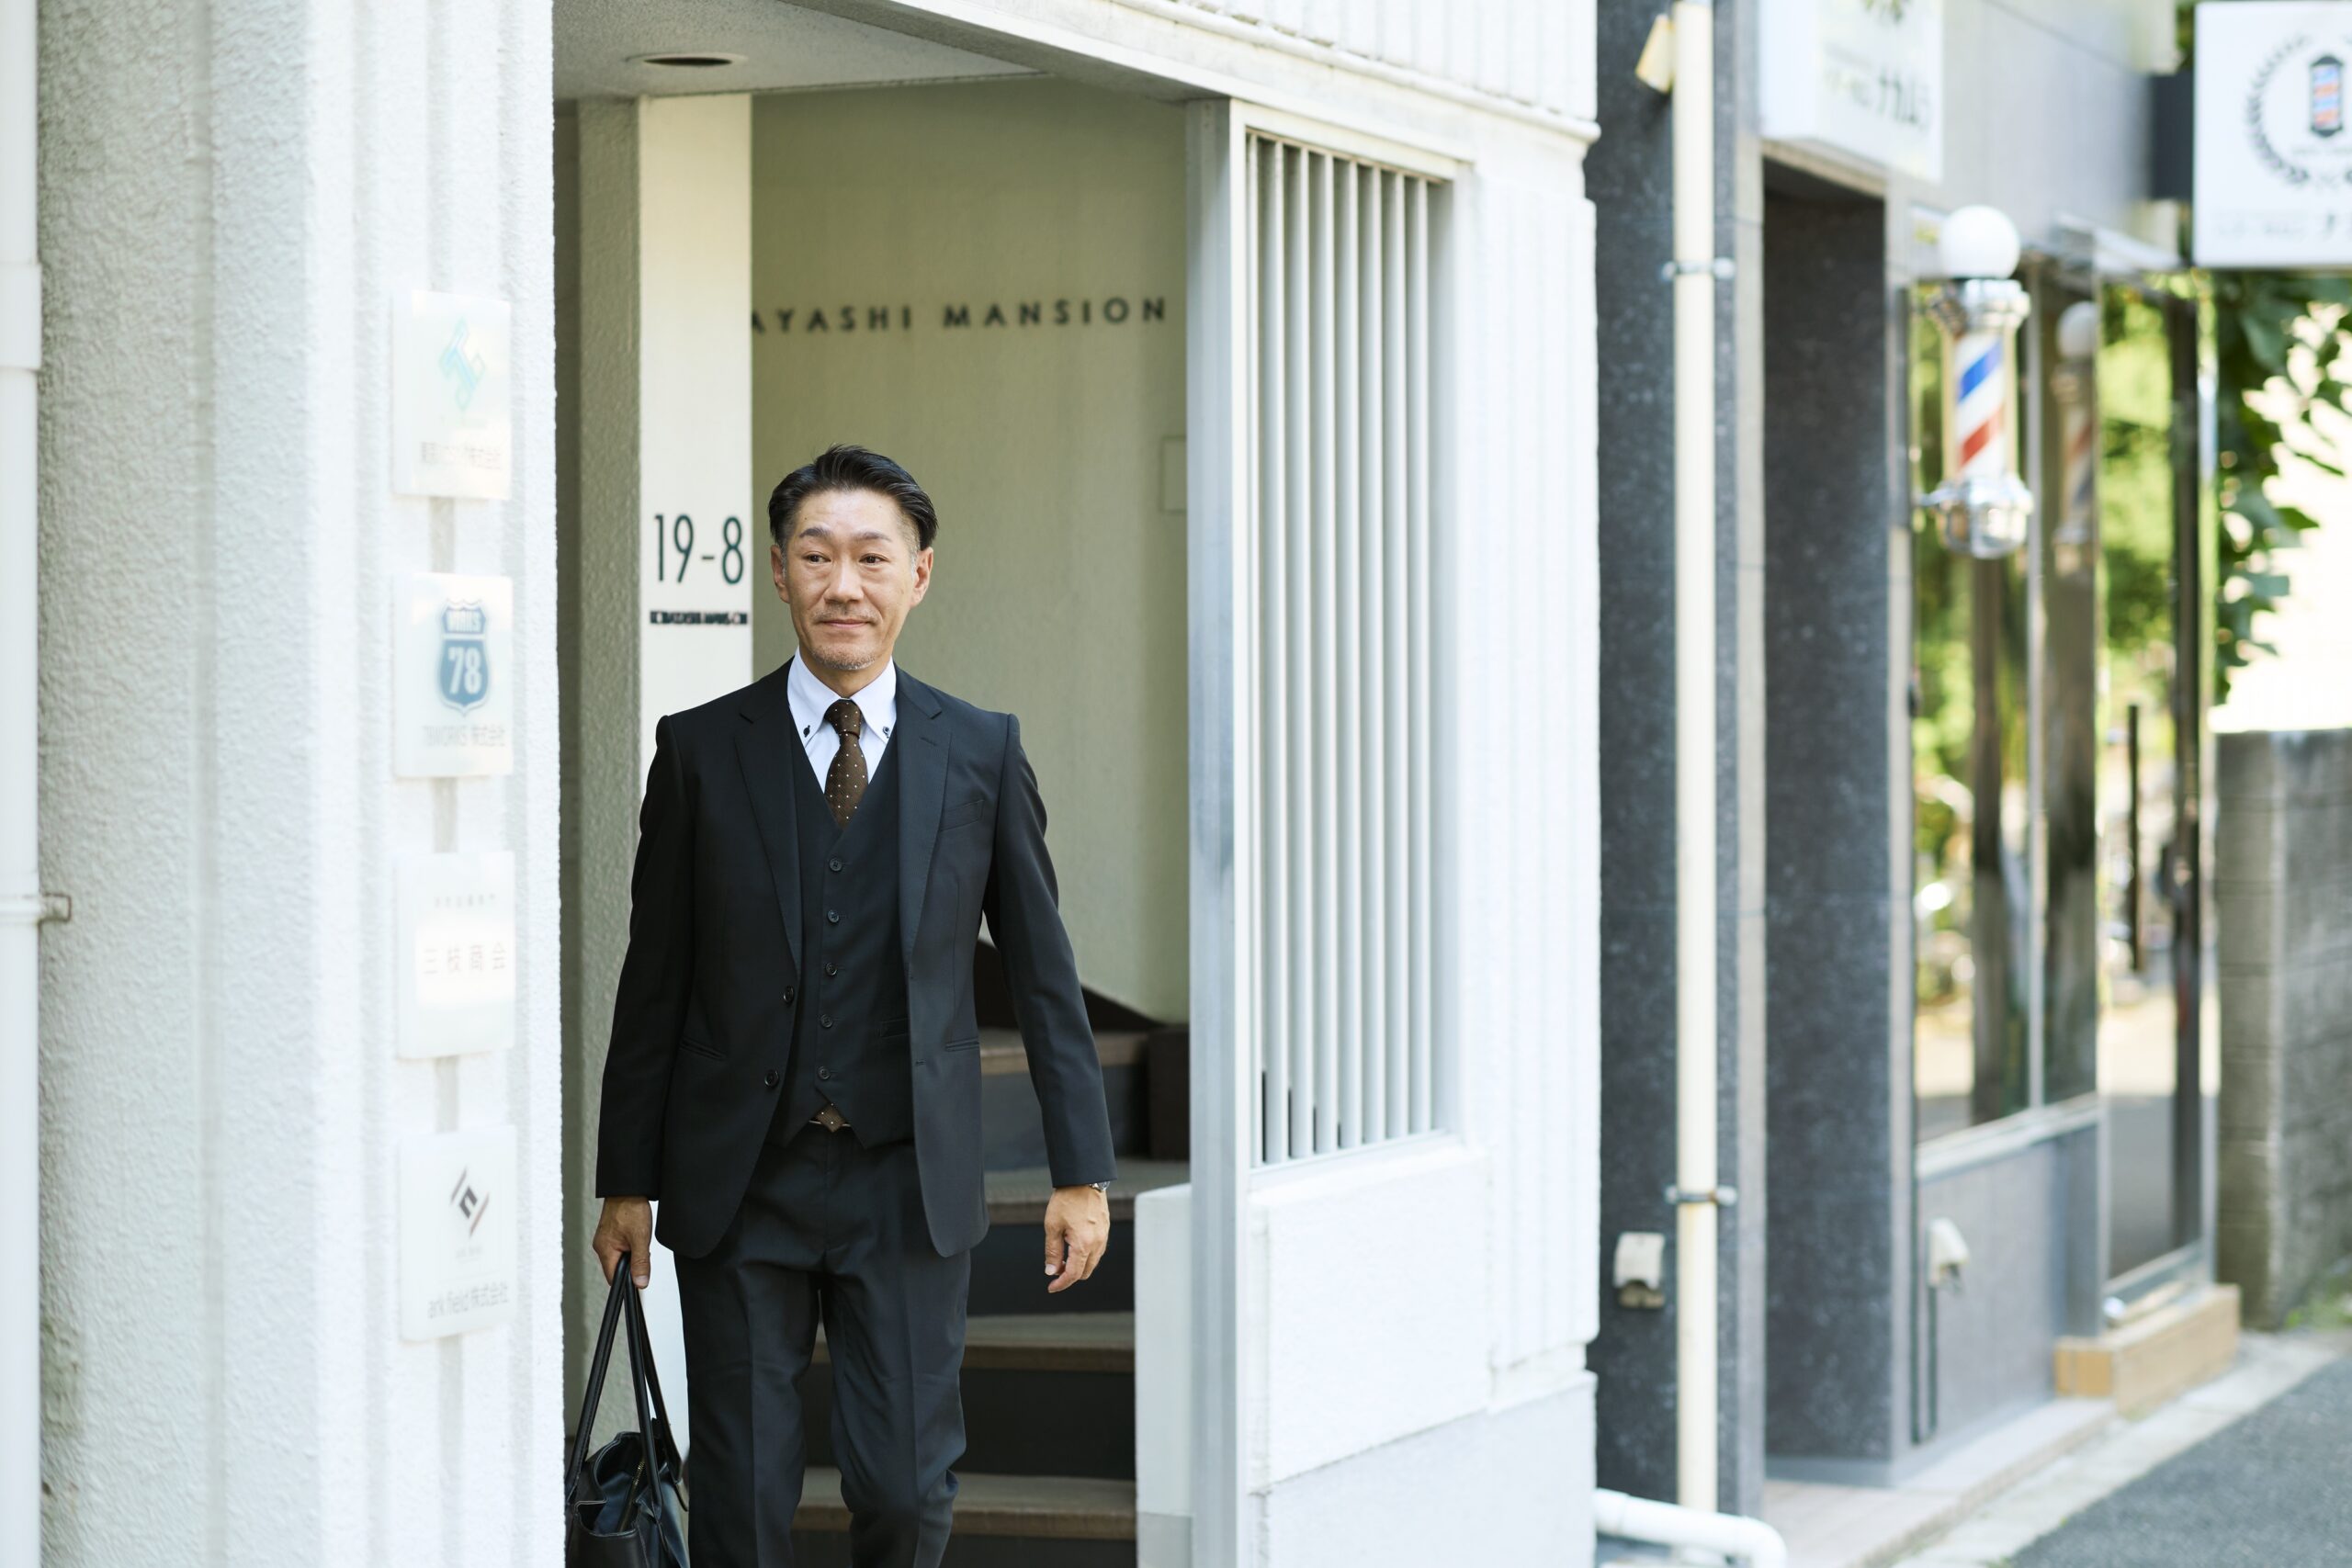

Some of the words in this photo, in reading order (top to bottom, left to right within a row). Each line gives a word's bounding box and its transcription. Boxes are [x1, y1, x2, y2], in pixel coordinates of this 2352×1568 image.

[944, 296, 1166, 328] MANSION
[654, 513, 744, 586] 19-8
[447, 646, 483, 696] 78
